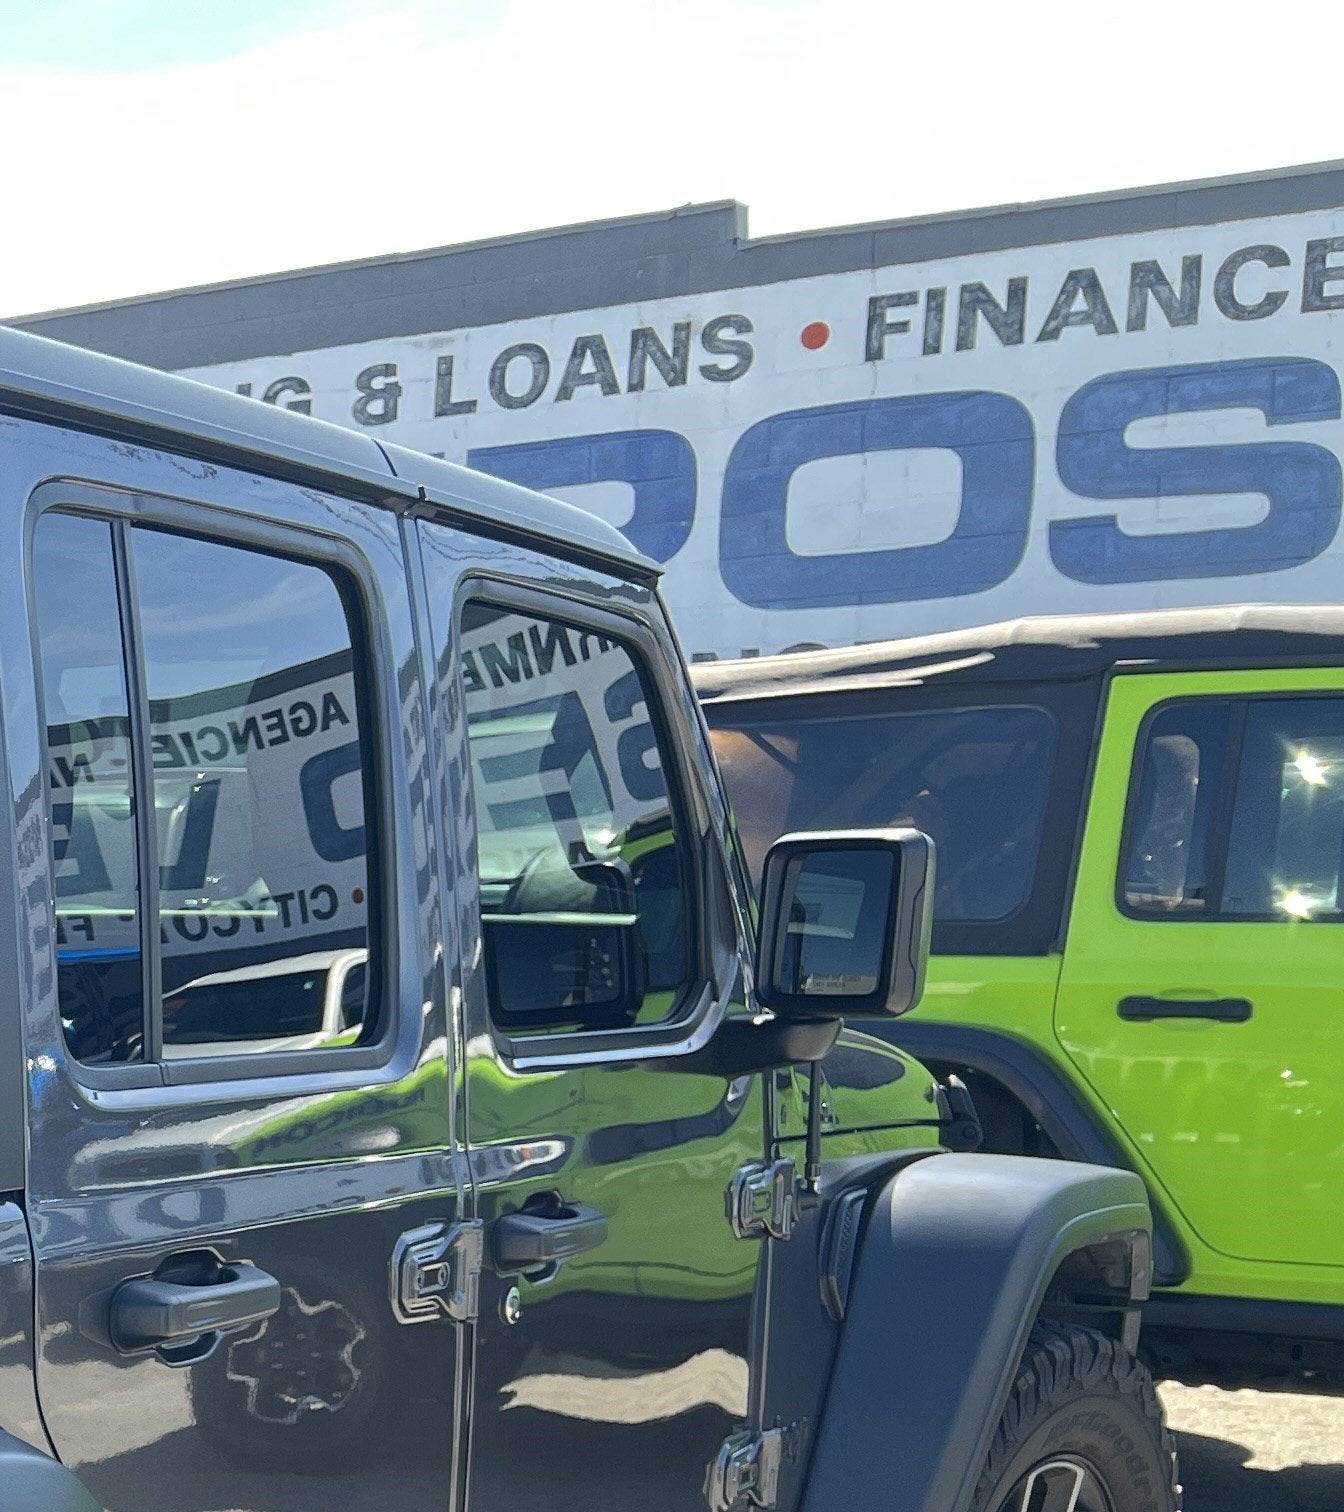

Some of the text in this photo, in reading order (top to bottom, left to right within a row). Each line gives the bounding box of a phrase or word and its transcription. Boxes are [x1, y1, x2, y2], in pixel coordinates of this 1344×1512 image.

[352, 363, 402, 426] &
[435, 313, 755, 418] LOANS
[863, 236, 1344, 364] FINANCE
